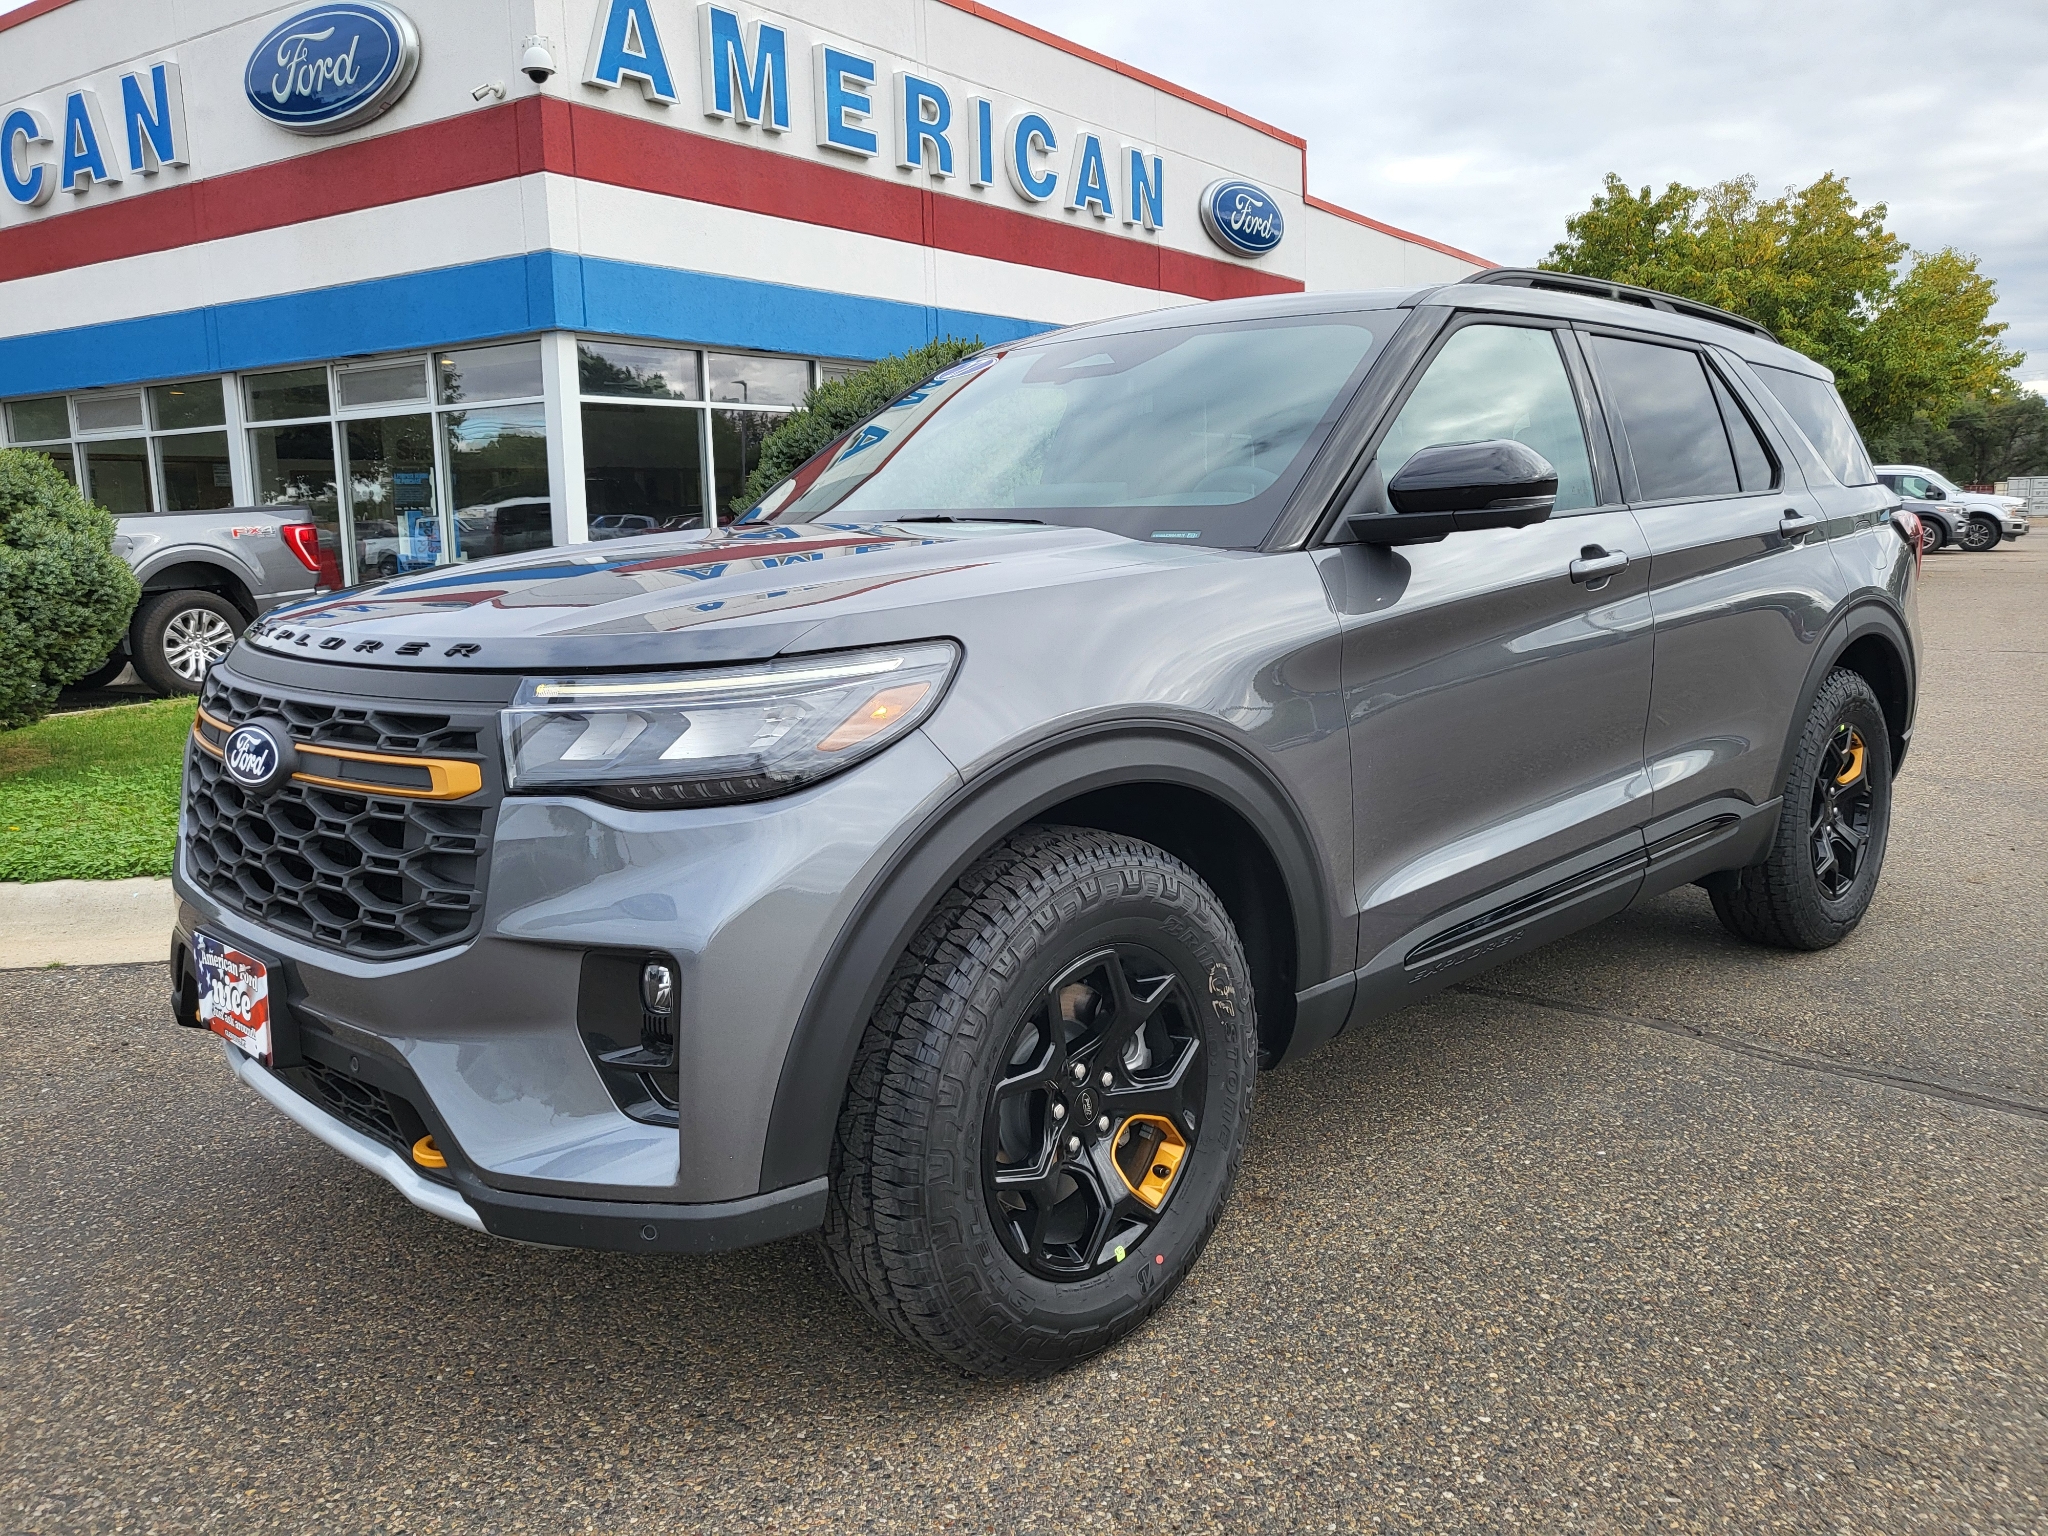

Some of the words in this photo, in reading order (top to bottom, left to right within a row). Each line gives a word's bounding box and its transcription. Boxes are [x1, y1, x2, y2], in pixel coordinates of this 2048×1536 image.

[272, 27, 360, 103] Ford
[0, 62, 186, 206] CAN
[582, 0, 1166, 230] AMERICAN
[1231, 194, 1273, 239] Ford
[231, 733, 269, 776] Ford
[200, 949, 238, 976] American
[1408, 929, 1526, 984] EXPLORER
[212, 976, 252, 1021] nice
